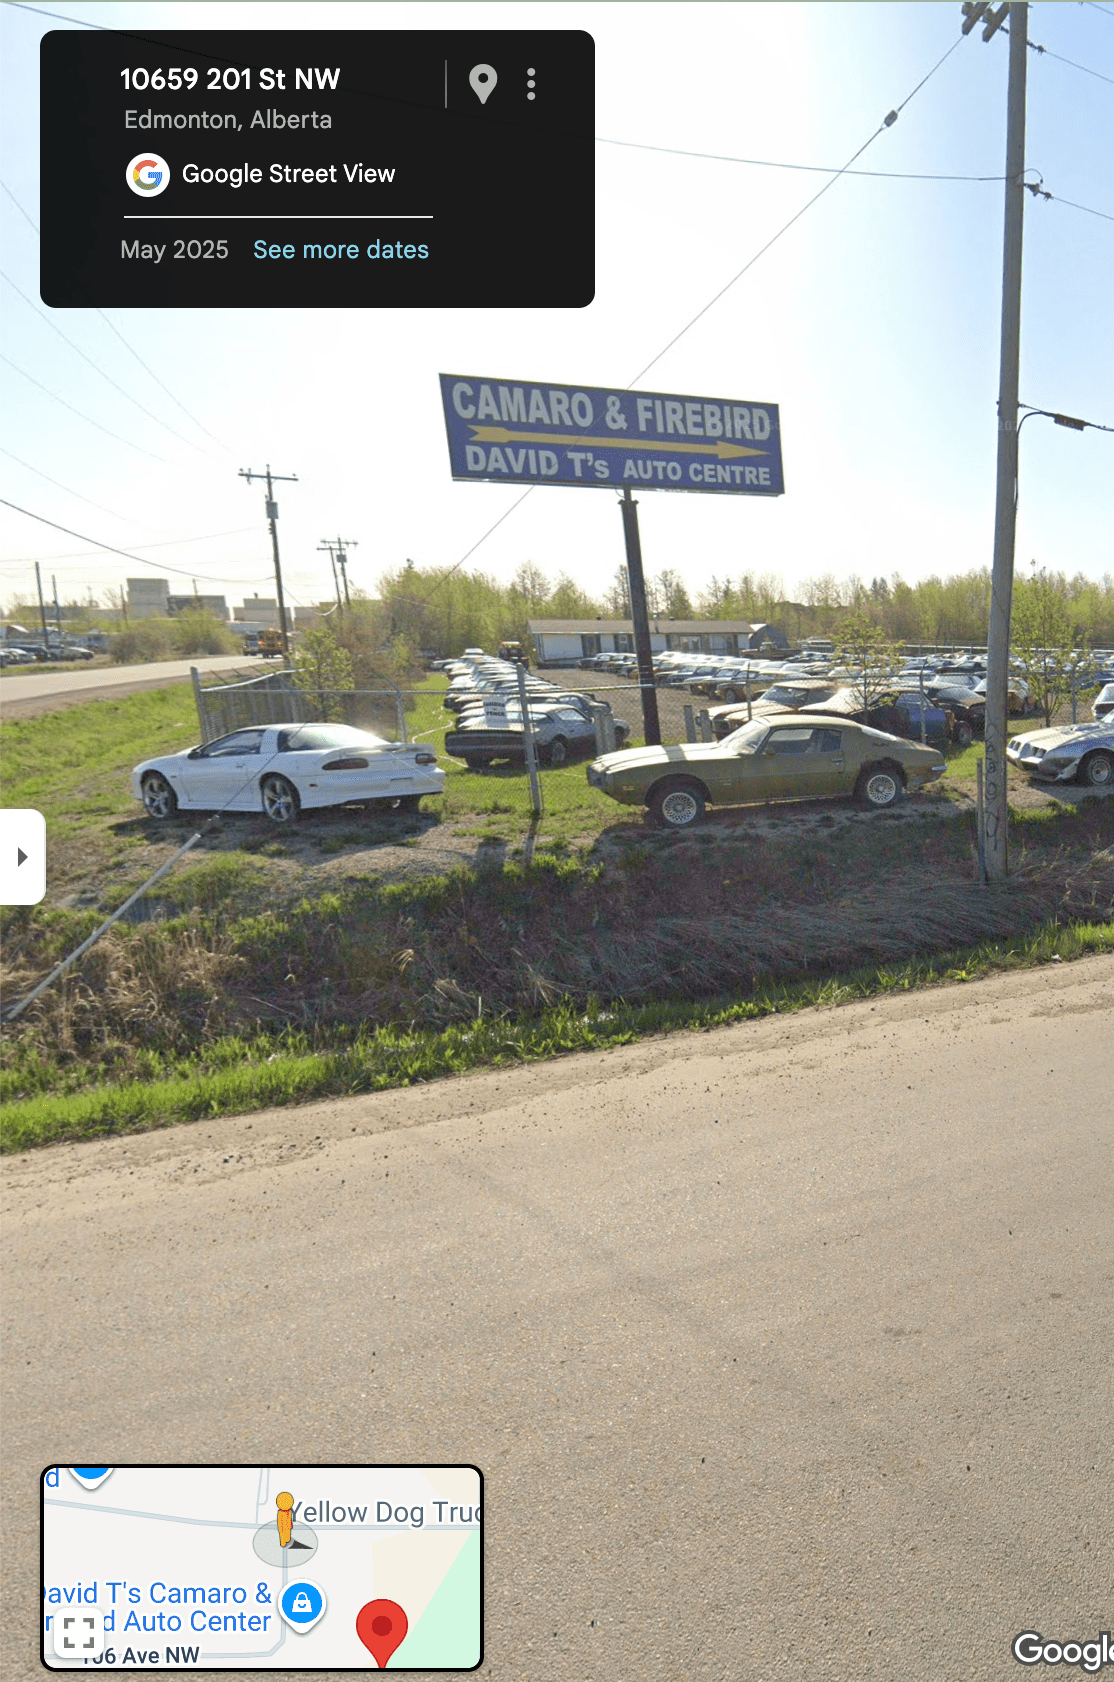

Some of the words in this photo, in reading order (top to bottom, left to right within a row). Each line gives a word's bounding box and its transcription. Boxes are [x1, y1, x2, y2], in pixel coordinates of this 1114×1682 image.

[452, 381, 594, 429] CAMARO
[604, 395, 628, 432] &
[636, 397, 771, 442] FIREBIRD
[465, 445, 560, 476] DAVID
[623, 459, 683, 481] AUTO
[689, 465, 772, 486] CENTRE
